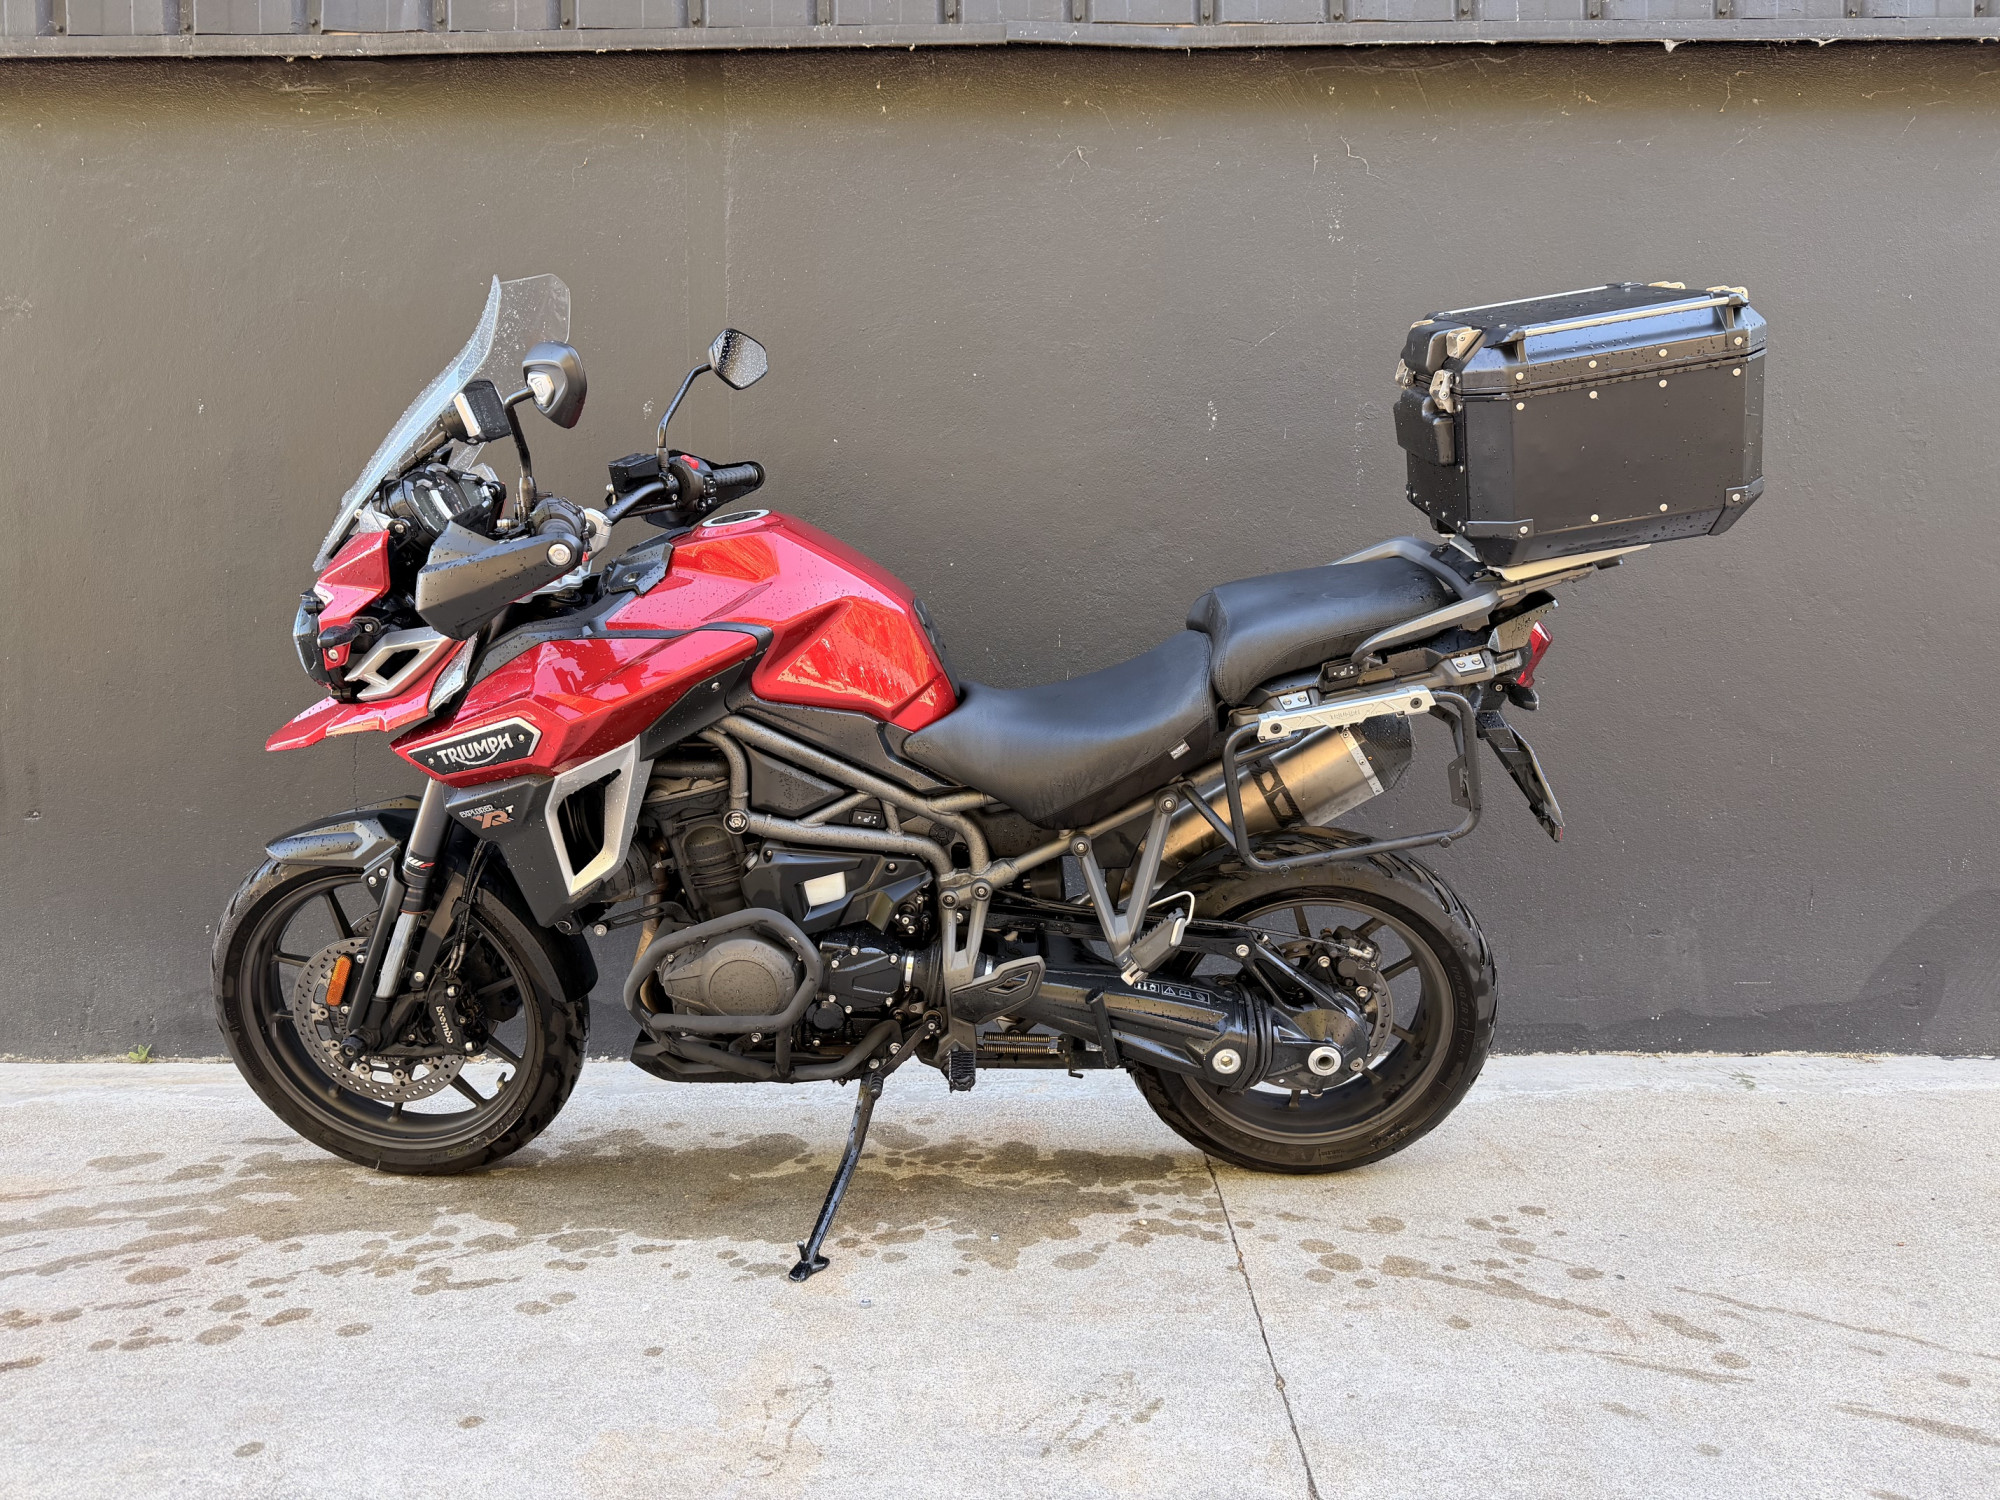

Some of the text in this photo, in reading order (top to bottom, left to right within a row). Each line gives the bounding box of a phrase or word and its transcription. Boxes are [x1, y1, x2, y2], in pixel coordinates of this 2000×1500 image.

[436, 732, 514, 765] TRIUMPH
[459, 804, 494, 818] EXPLORER
[435, 1005, 454, 1044] brembo
